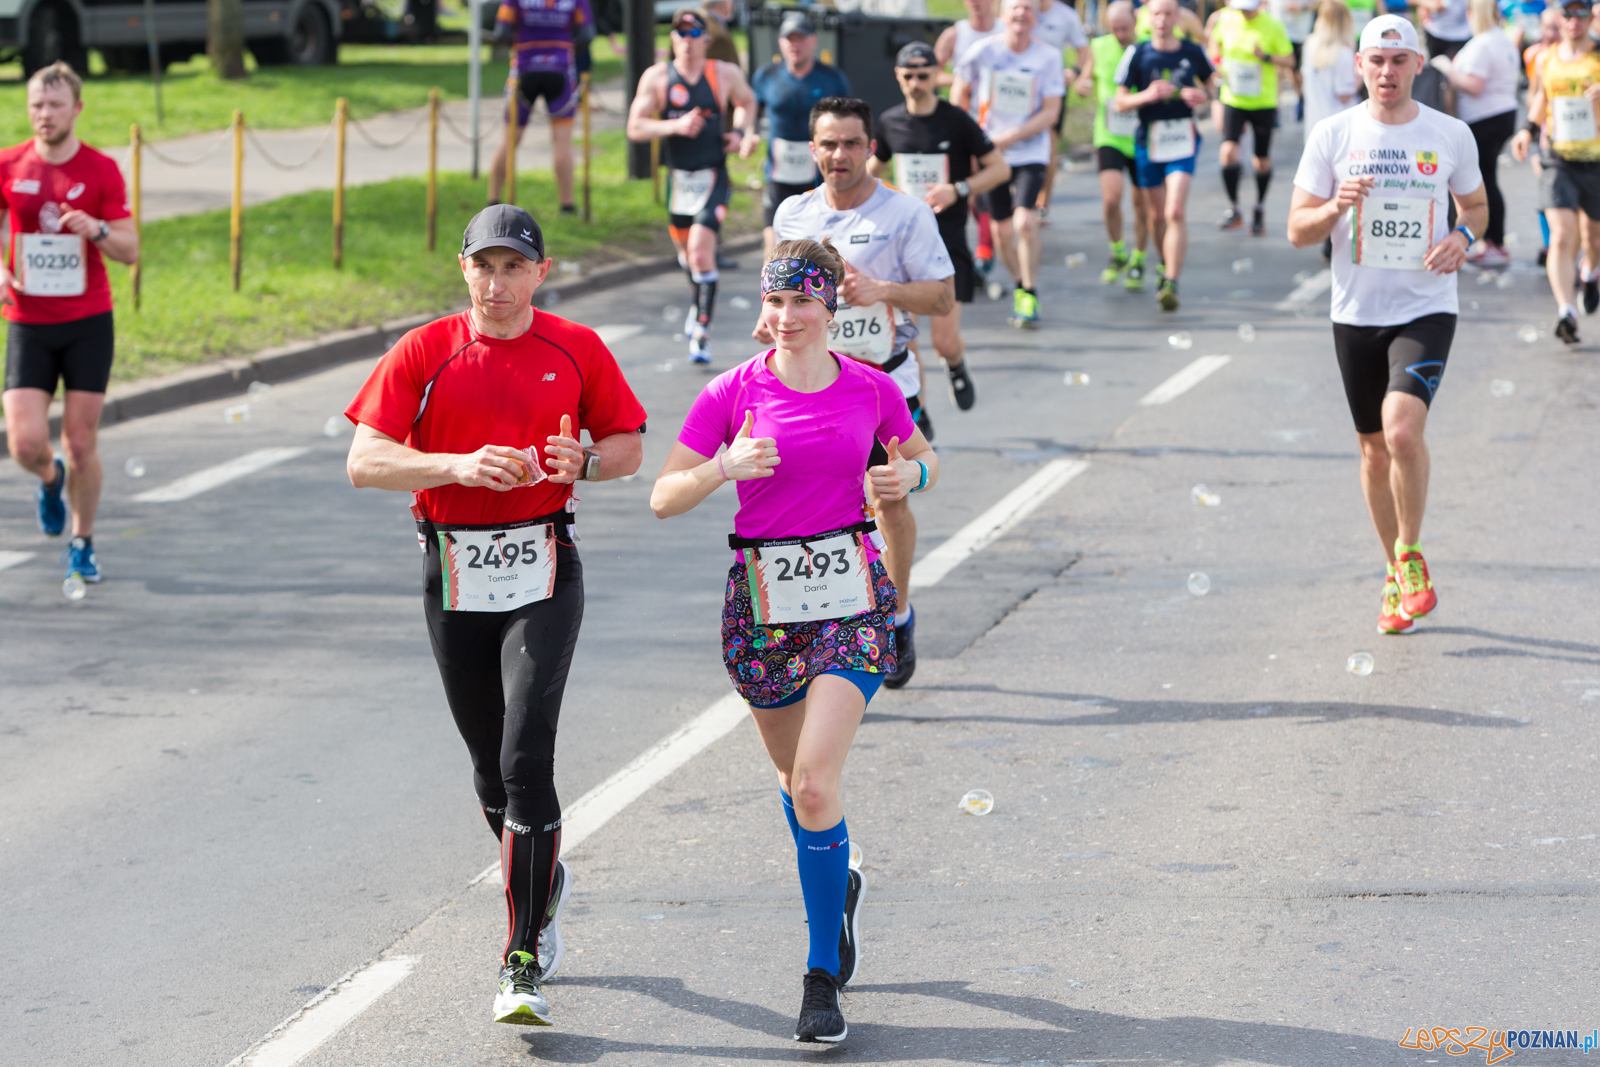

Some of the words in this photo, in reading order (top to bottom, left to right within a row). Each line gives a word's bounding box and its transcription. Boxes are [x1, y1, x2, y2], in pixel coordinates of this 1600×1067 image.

[1350, 150, 1366, 160] KB
[1370, 149, 1407, 160] GMINA
[1349, 161, 1411, 175] CZARNKÓW
[1371, 220, 1422, 239] 8822
[27, 253, 80, 269] 10230
[763, 538, 802, 547] performance
[466, 540, 538, 569] 2495
[774, 548, 850, 581] 2493
[488, 573, 519, 583] Tomasz
[804, 583, 828, 593] Daria
[511, 822, 532, 834] cep
